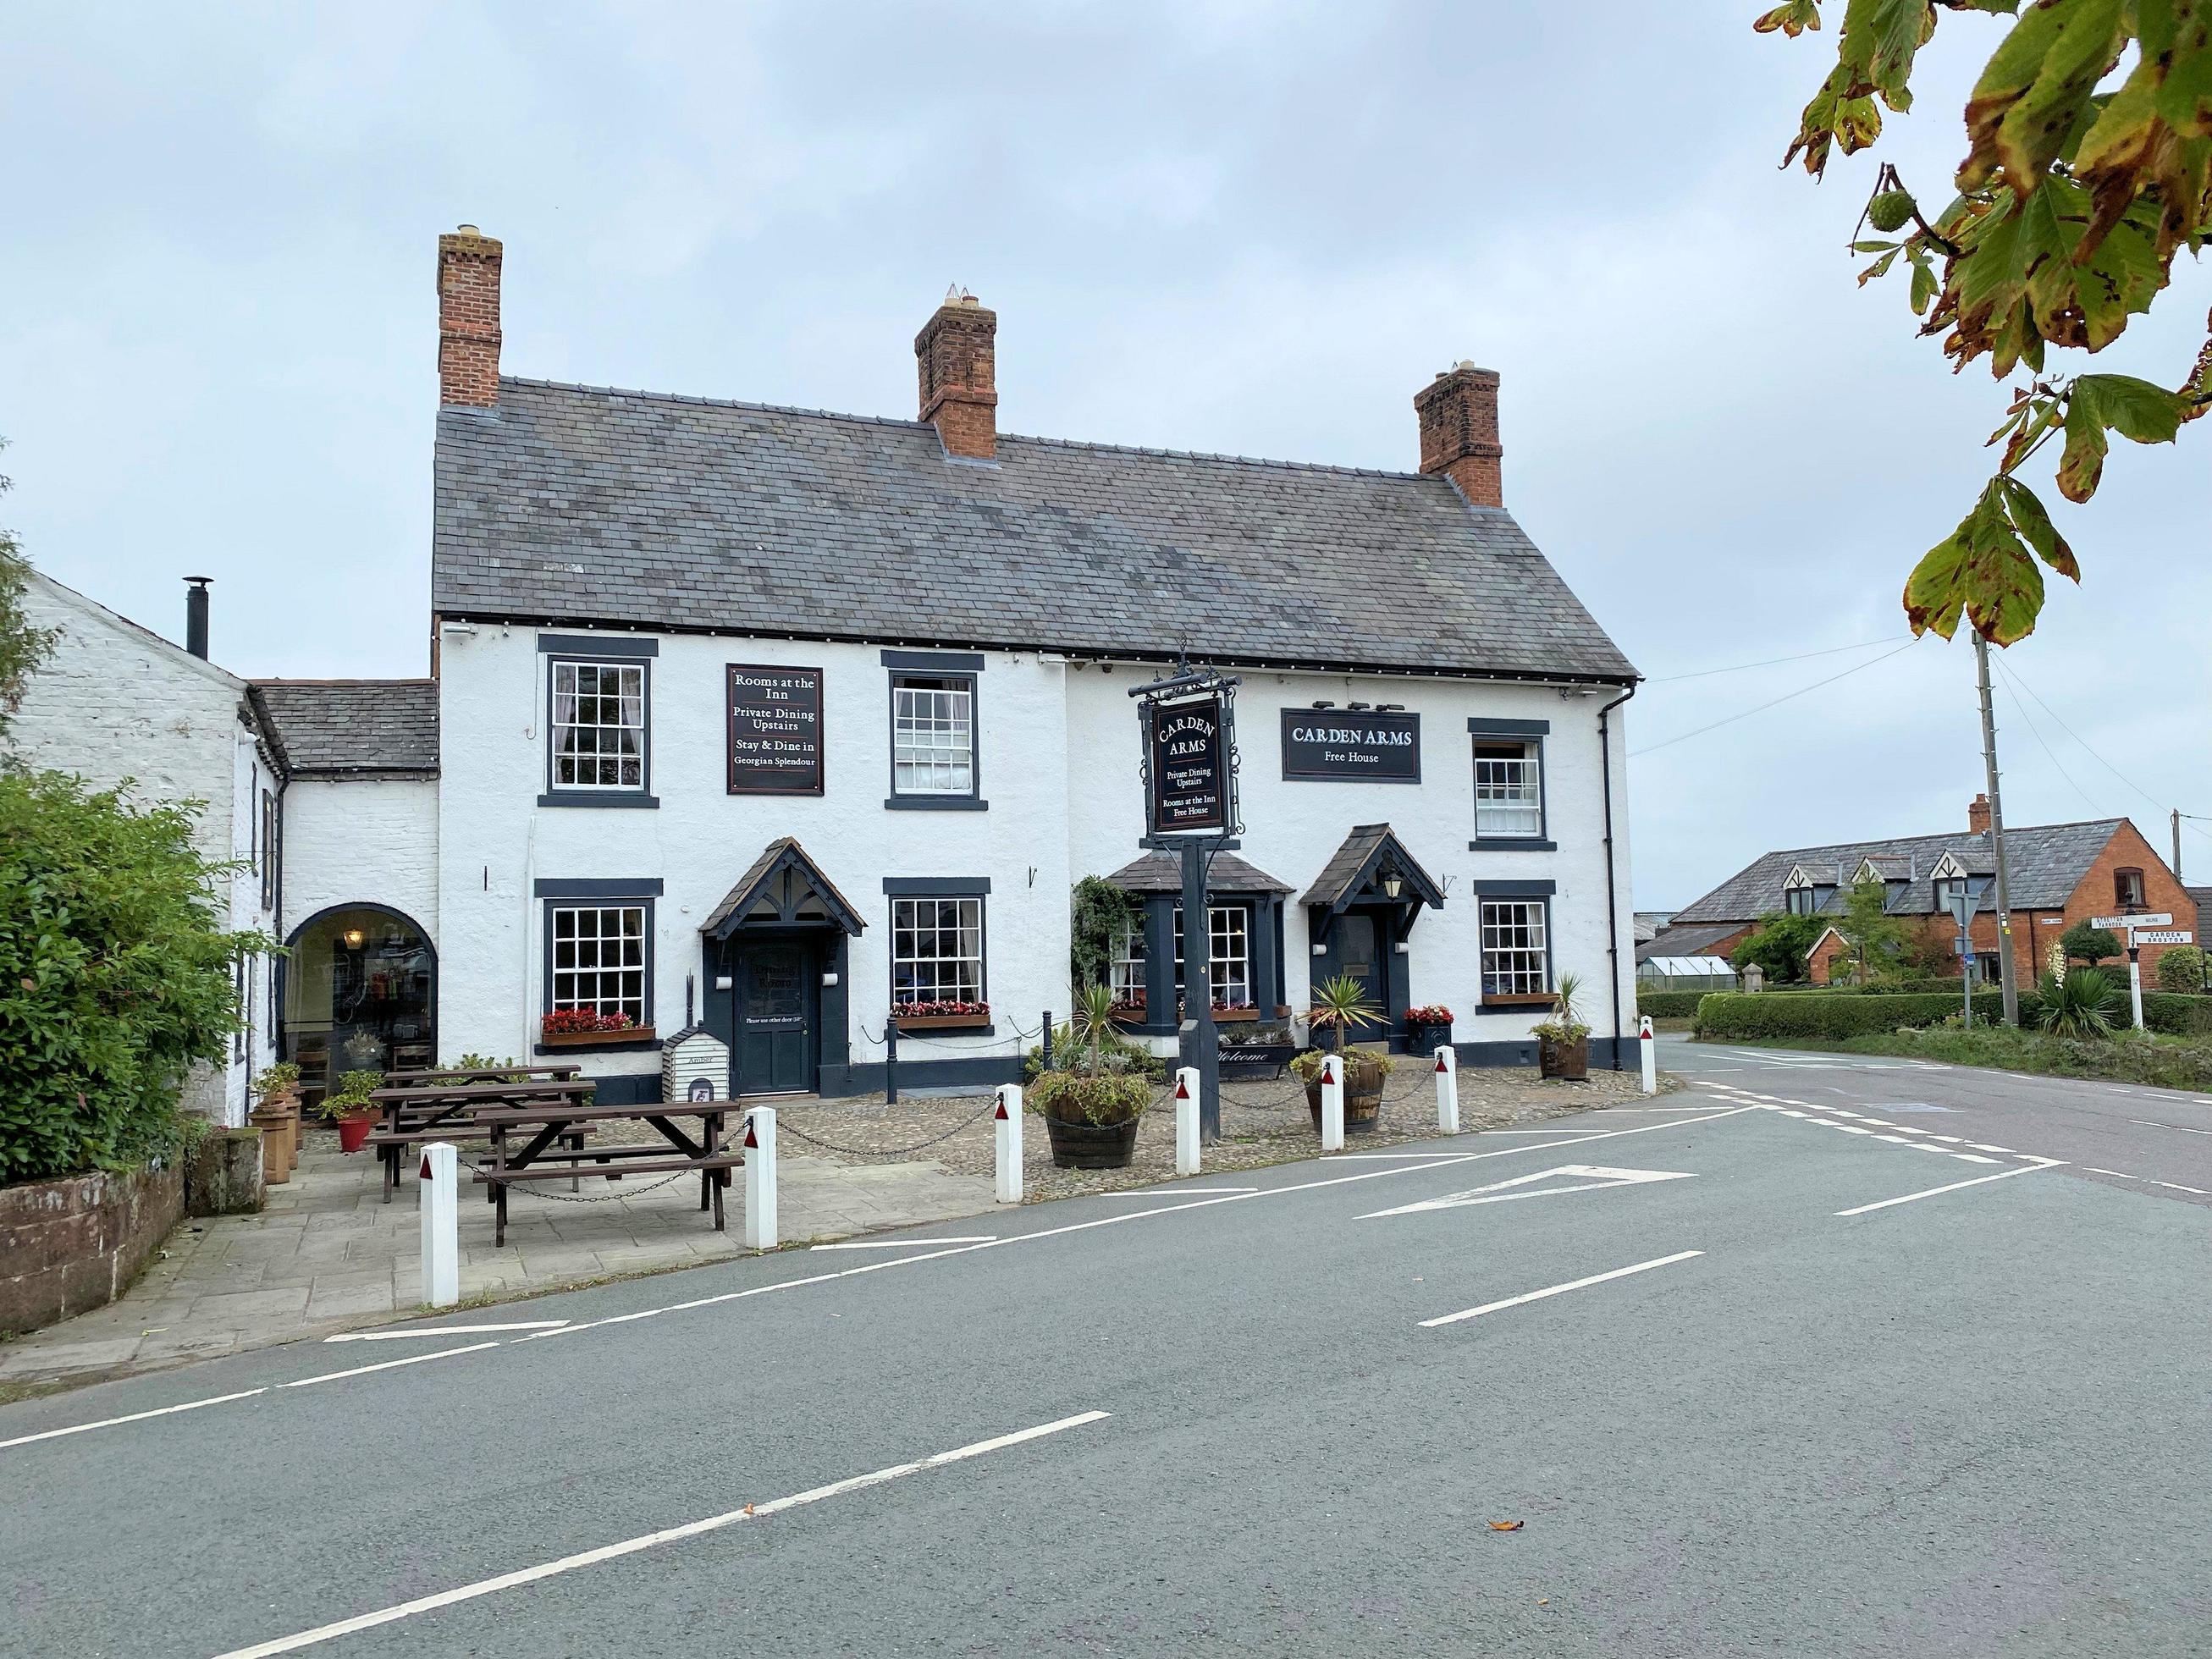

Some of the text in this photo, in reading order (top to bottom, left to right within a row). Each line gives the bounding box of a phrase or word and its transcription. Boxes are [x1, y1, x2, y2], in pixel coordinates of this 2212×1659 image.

[735, 674, 814, 689] Rooms at the
[765, 688, 789, 700] Inn
[733, 707, 815, 722] Private Dining
[753, 719, 799, 731] Upstairs
[1159, 716, 1216, 743] CARDEN
[1292, 727, 1412, 746] CARDEN ARMS
[736, 740, 815, 752] Stay & Dine in
[1169, 739, 1206, 755] ARMS
[734, 756, 816, 768] Georgian Splendour
[1325, 751, 1379, 763] Free House
[1167, 767, 1211, 780] Private Dining
[1177, 777, 1203, 789] Upstairs
[1162, 798, 1184, 807] Rooms
[1193, 796, 1203, 804] the
[1204, 795, 1216, 803] Inn
[1173, 806, 1209, 817] Free House
